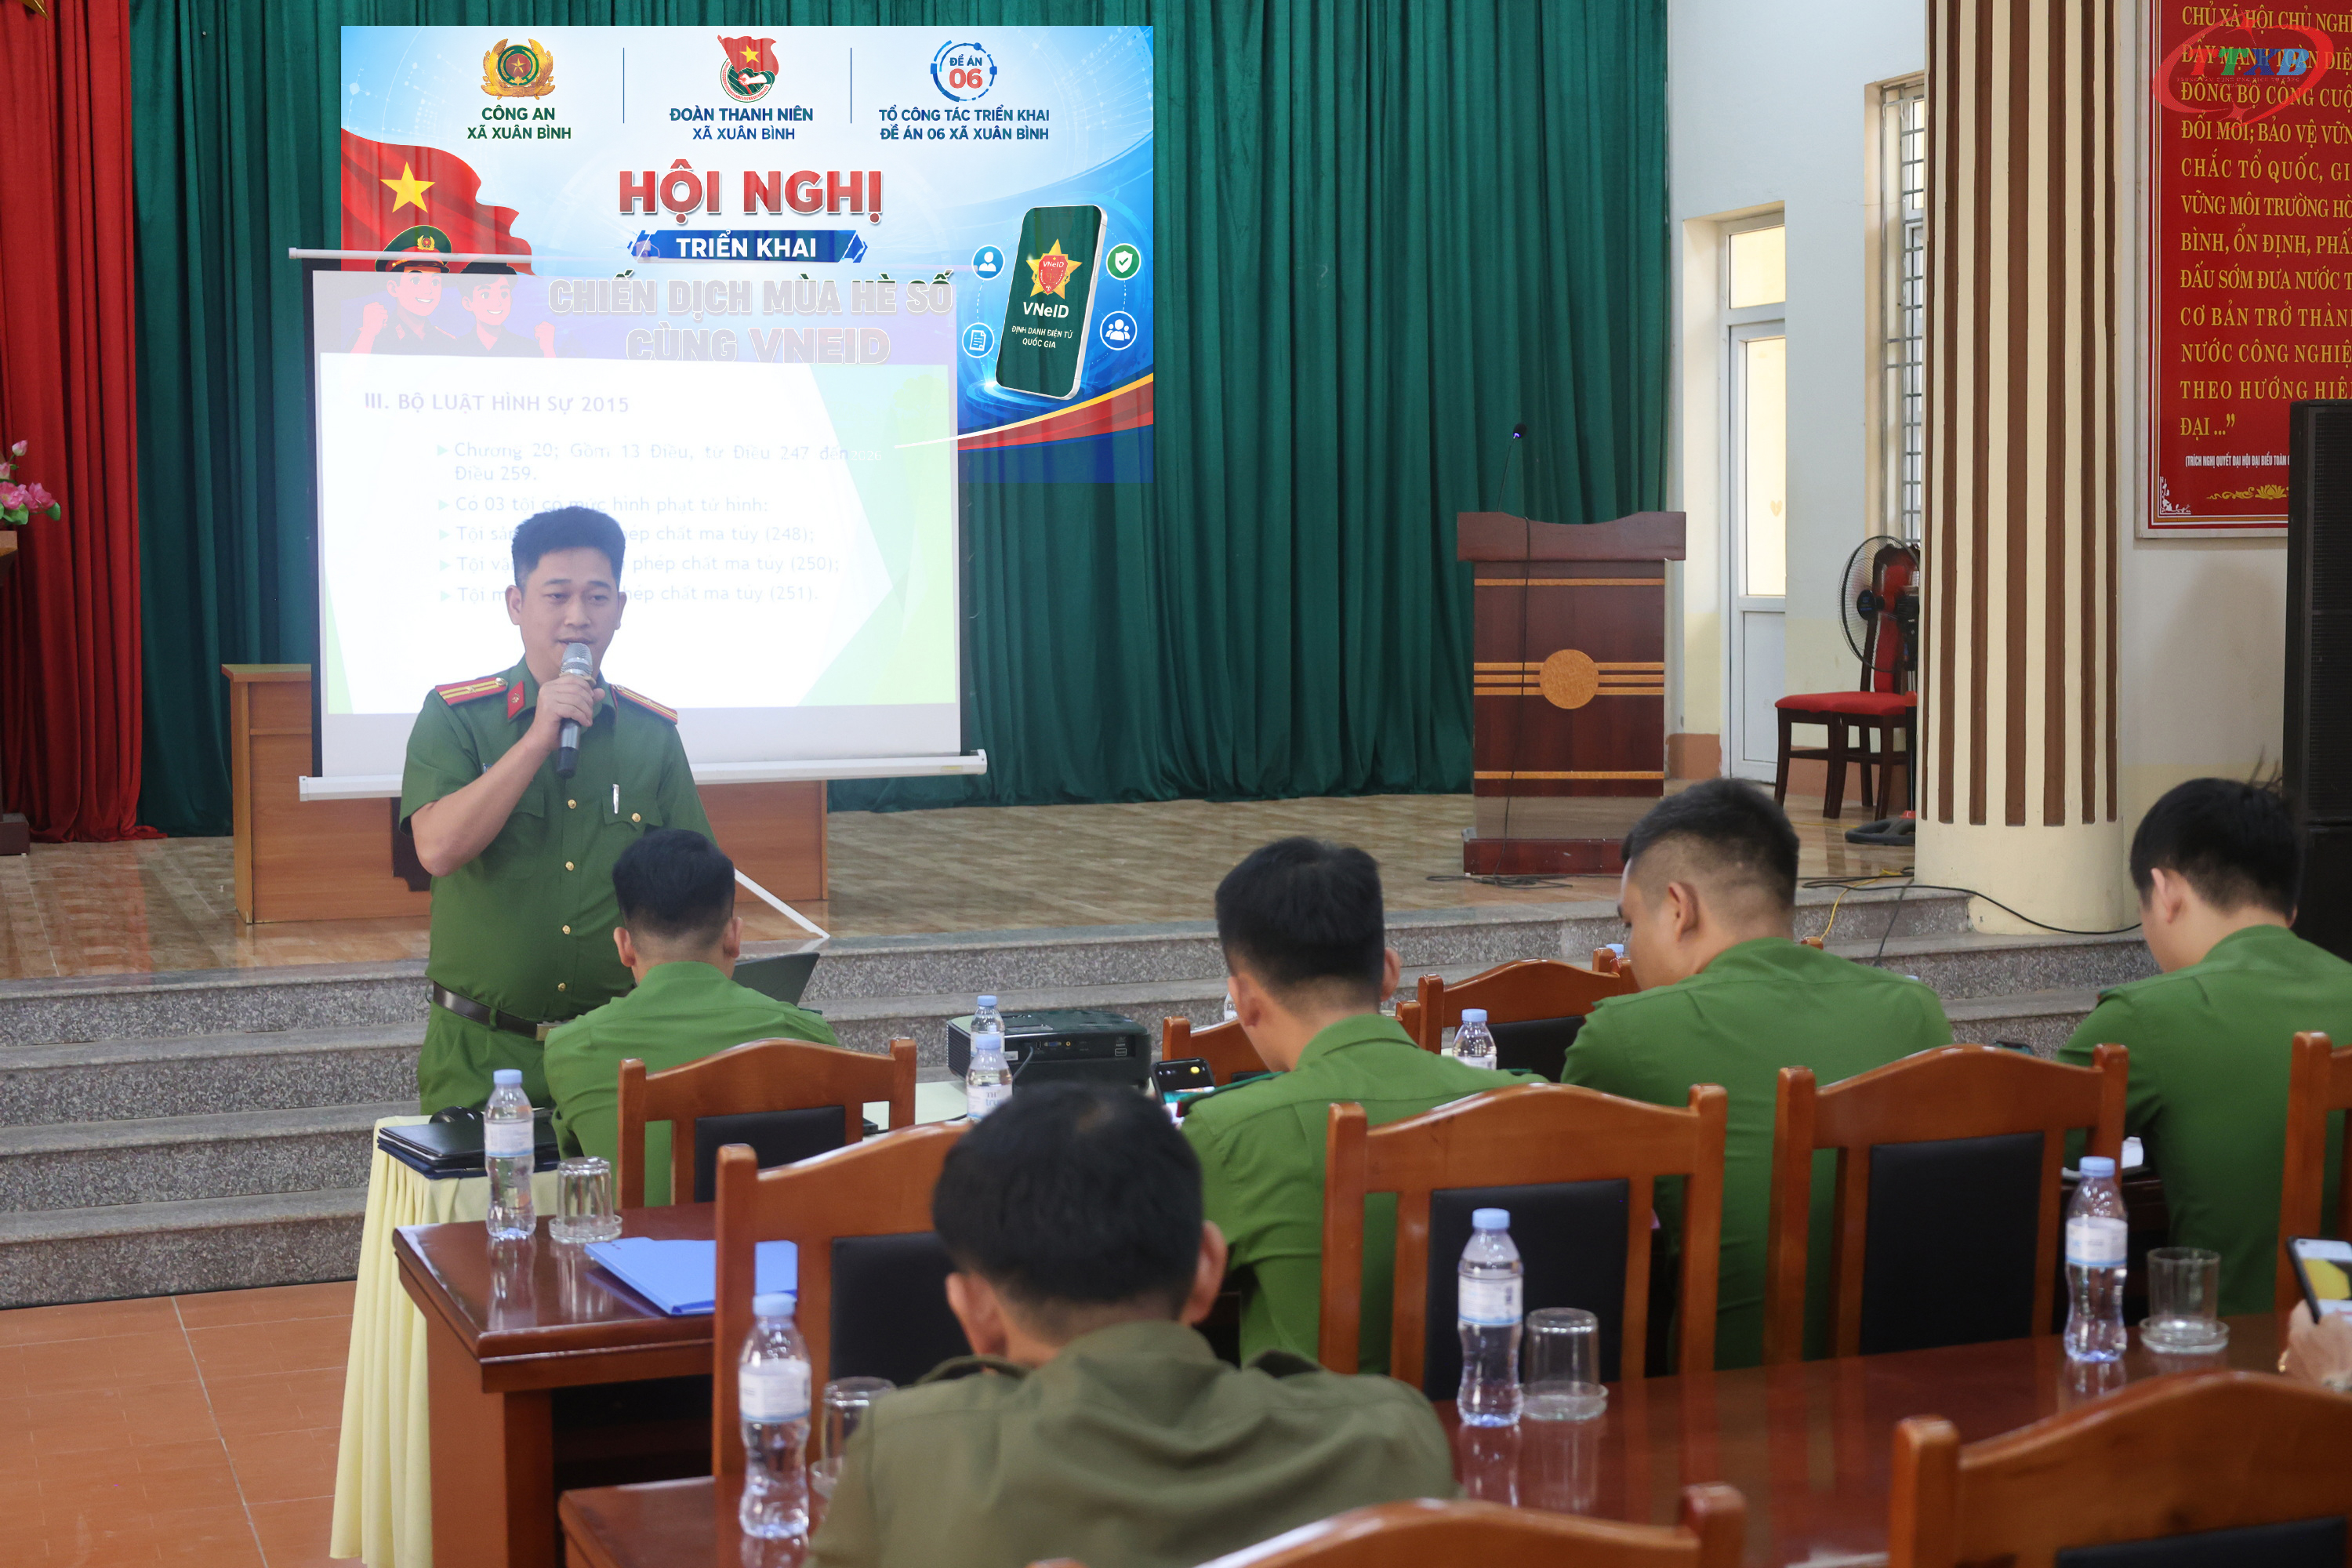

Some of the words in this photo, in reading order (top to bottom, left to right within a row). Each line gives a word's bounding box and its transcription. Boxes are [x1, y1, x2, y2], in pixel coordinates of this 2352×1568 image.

[2183, 1, 2216, 27] CHỦ
[2220, 3, 2241, 27] XÃ
[2245, 4, 2274, 34] HỘI
[2278, 5, 2312, 31] CHỦ
[967, 56, 982, 66] ÁN
[949, 68, 982, 89] 06
[2181, 73, 2231, 103] ĐỒNG
[2237, 79, 2261, 109] BỘ
[2267, 81, 2314, 107] CÔNG
[481, 105, 528, 121] CÔNG
[532, 107, 555, 121] AN
[670, 105, 714, 122] ĐOÀN
[719, 108, 772, 122] THANH
[778, 105, 813, 122] NIÊN
[879, 104, 898, 122] TỔ
[902, 105, 941, 122] CÔNG
[945, 105, 971, 122] TÁC
[974, 104, 1013, 122] TRIỂN
[1018, 109, 1050, 122] KHAI
[467, 125, 488, 140] XÃ
[492, 125, 532, 140] XUÂN
[537, 125, 572, 140] BÌNH
[692, 125, 713, 140] XÃ
[717, 125, 757, 140] XUÂN
[761, 125, 795, 140] BÌNH
[880, 123, 899, 140] ĐỀ
[903, 124, 923, 140] ÁN
[927, 128, 945, 140] 06
[949, 125, 969, 140] XÃ
[973, 125, 1011, 140] XUÂN
[1015, 125, 1049, 140] BÌNH
[2181, 111, 2212, 140] ĐỔI
[2258, 116, 2291, 143] BẢO
[2296, 119, 2318, 149] VỆ
[2181, 148, 2232, 178] CHẮC
[2238, 149, 2262, 179] TỔ
[2267, 152, 2323, 183] QUỐC,
[619, 158, 722, 225] HỘI
[743, 170, 883, 225] NGHỊ
[2181, 190, 2226, 215] VỮNG
[2230, 191, 2260, 216] MÔI
[2264, 192, 2328, 218] TRƯỜNG
[677, 228, 748, 258] TRIỂN
[757, 238, 816, 258] KHAI
[2181, 227, 2230, 254] BÌNH,
[2234, 223, 2258, 252] ỔN
[2263, 234, 2311, 258] ĐỊNH,
[2180, 260, 2215, 289] ĐẤU
[2219, 263, 2253, 289] SỚM
[2257, 269, 2292, 289] ĐƯA
[2295, 265, 2340, 290] NƯỚC
[547, 270, 657, 314] CHIẾN
[668, 278, 753, 321] DỊCH
[761, 273, 842, 314] MÙA
[850, 273, 897, 314] HÈ
[906, 269, 954, 314] SỐ
[1022, 301, 1069, 318] VNeID
[2180, 305, 2205, 326] CƠ
[2211, 299, 2249, 326] BẢN
[2255, 299, 2292, 327] TRỞ
[1011, 325, 1026, 335] ĐỊNH
[1028, 328, 1046, 337] DANH
[1047, 327, 1062, 339] ĐIỆN
[1022, 336, 1042, 347] QUỐC
[1044, 340, 1056, 349] GIA
[626, 322, 738, 363] CÙNG
[750, 327, 891, 365] VNEID
[2181, 337, 2233, 362] NƯỚC
[2239, 339, 2288, 363] CÔNG
[2180, 380, 2232, 399] THEO
[2239, 376, 2307, 400] HƯỚNG
[365, 393, 390, 410] III.
[398, 391, 424, 413] BỘ
[433, 391, 485, 413] LUẬT
[492, 391, 540, 412] HÌNH
[547, 395, 573, 415] SỰ
[582, 396, 629, 412] 2015
[2180, 416, 2209, 441] ĐẠI
[455, 442, 522, 460] Chương
[533, 443, 557, 459] 20;
[571, 443, 610, 459] Gồm
[622, 445, 640, 458] 13
[652, 445, 694, 462] Điều,
[734, 445, 771, 460] Điều
[782, 445, 809, 460] 247
[819, 445, 848, 461] đến
[851, 451, 882, 461] 2026
[455, 466, 494, 481] Điều
[501, 466, 537, 481] 259.
[456, 495, 478, 511] Có
[485, 497, 504, 511] 03
[513, 497, 535, 517] tội
[657, 496, 694, 517] phạt
[458, 526, 483, 543] Tội
[656, 526, 692, 541] chất
[699, 529, 724, 541] ma
[765, 527, 815, 545] (248);
[459, 556, 484, 574] Tội
[682, 555, 719, 571] chất
[726, 560, 750, 571] ma
[791, 557, 840, 576] (250);
[459, 586, 485, 604] Tội
[661, 584, 698, 601] chất
[704, 589, 728, 601] ma
[771, 586, 818, 604] (251).
